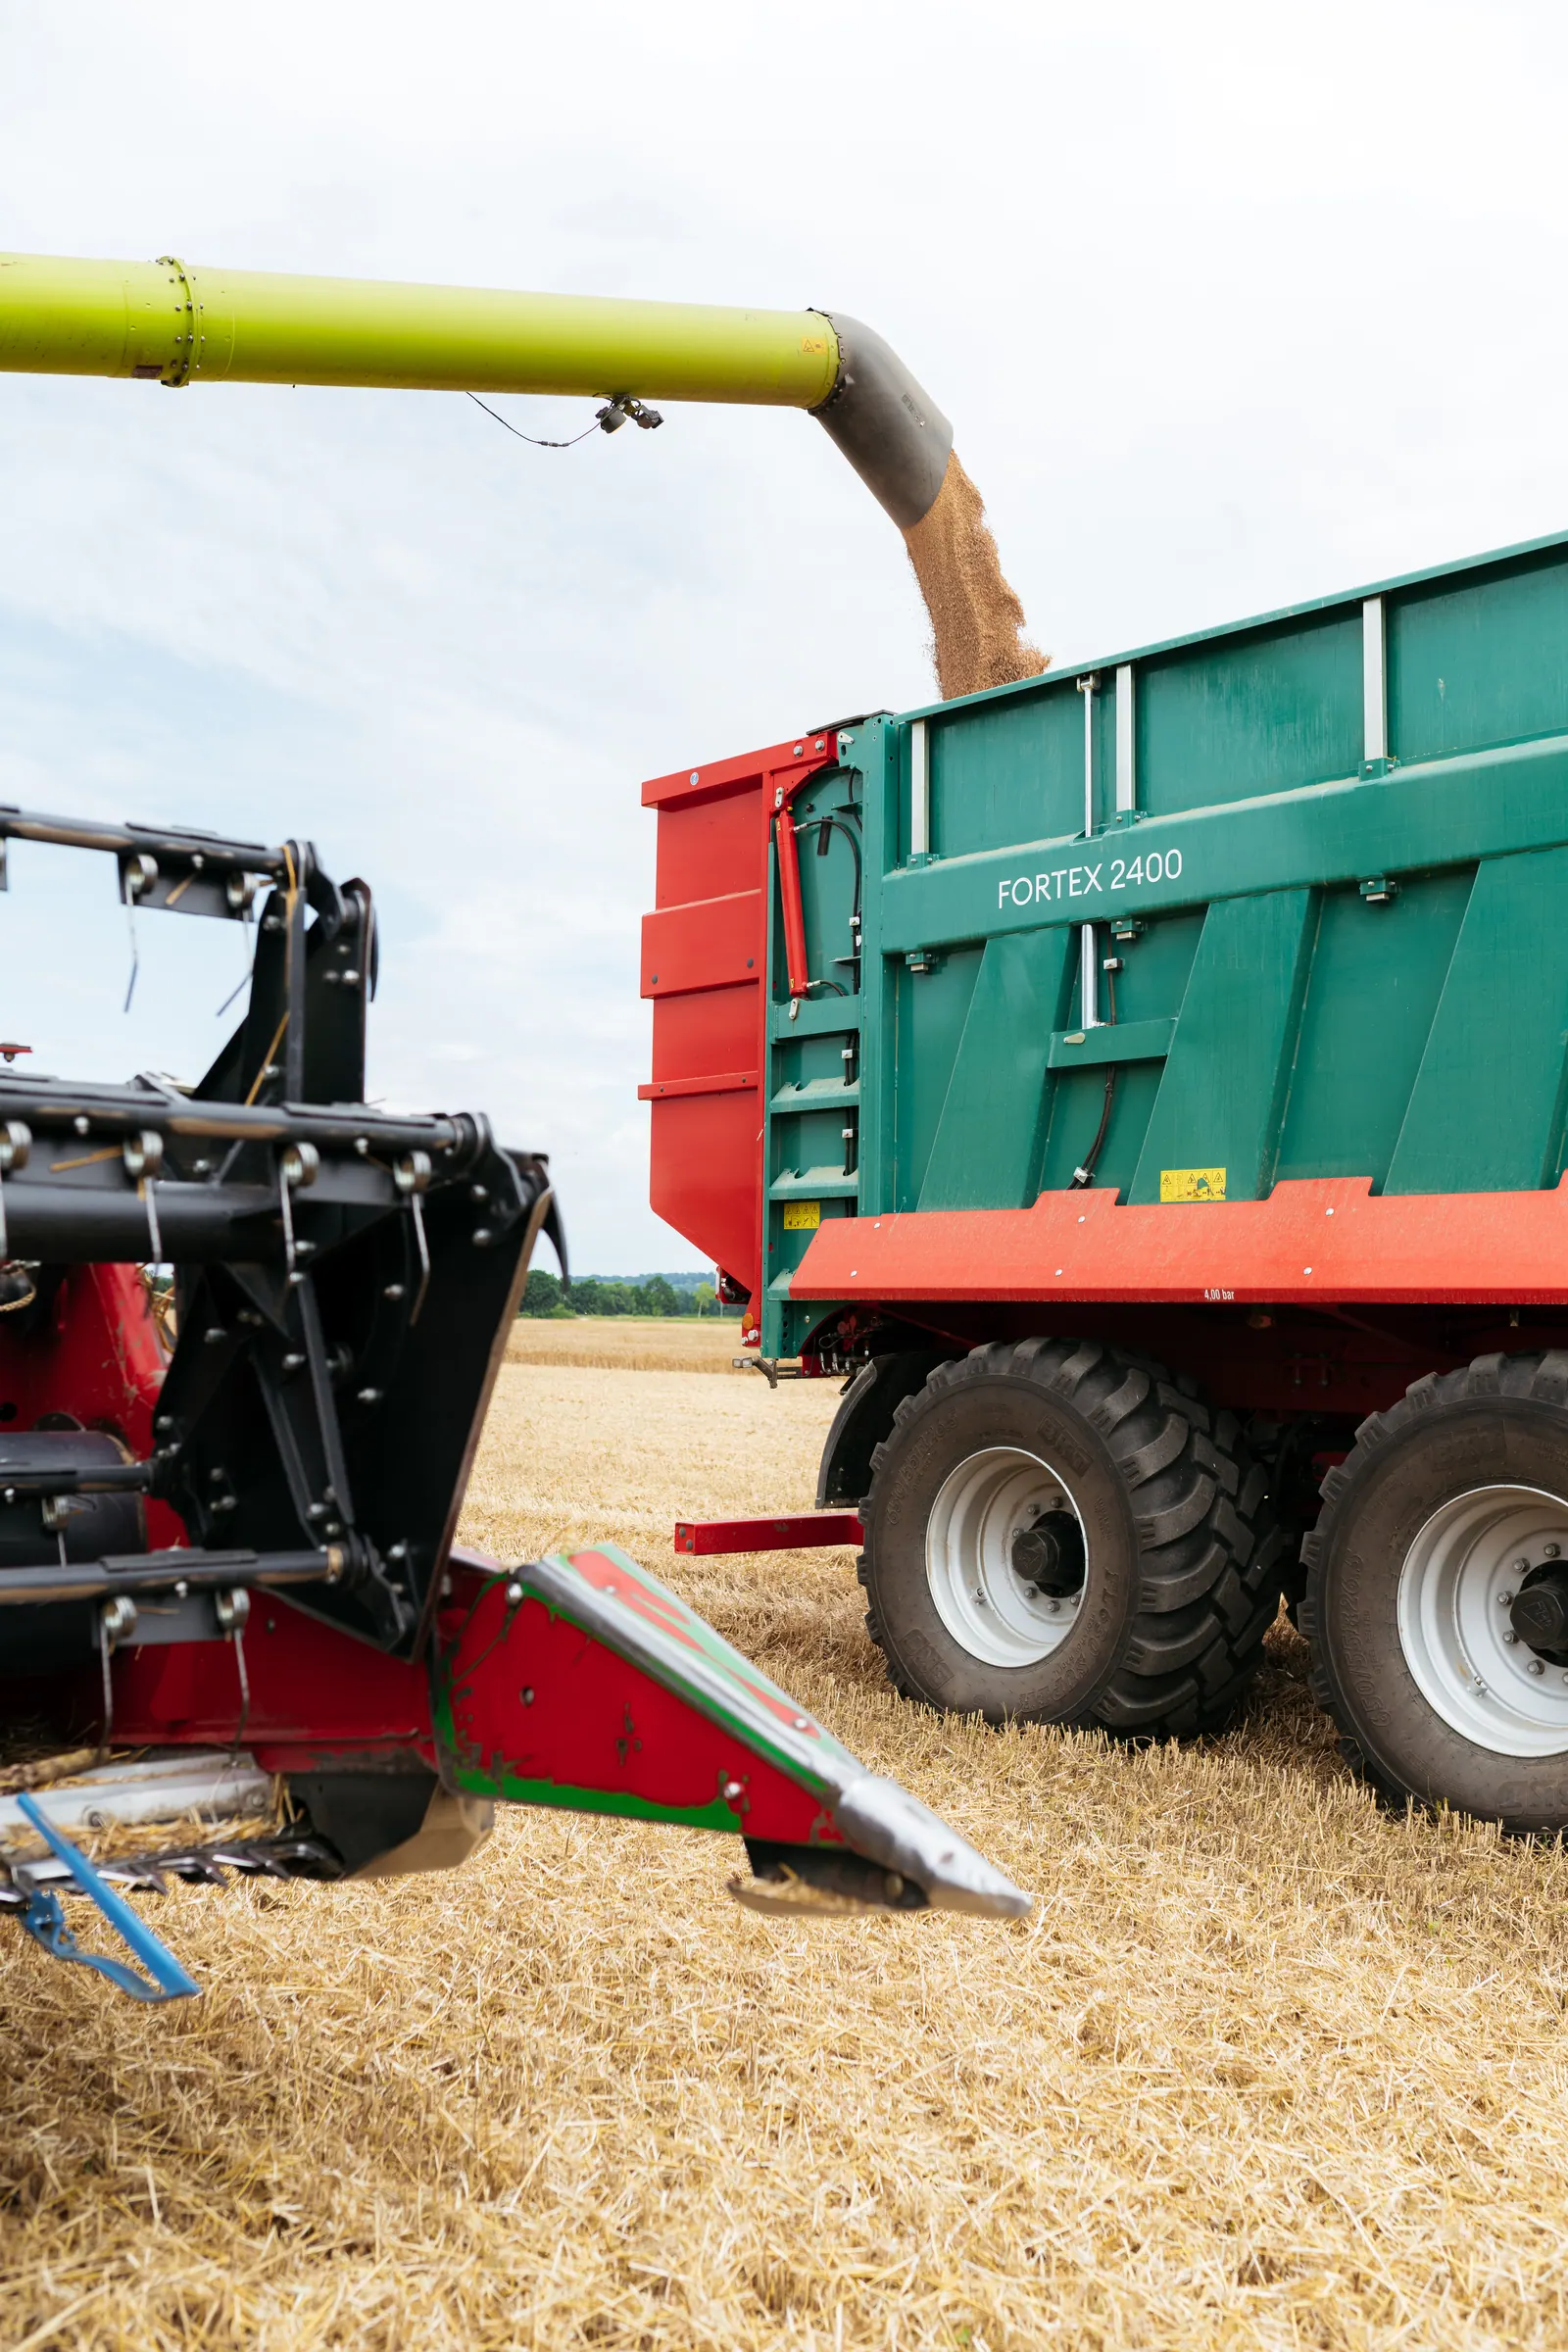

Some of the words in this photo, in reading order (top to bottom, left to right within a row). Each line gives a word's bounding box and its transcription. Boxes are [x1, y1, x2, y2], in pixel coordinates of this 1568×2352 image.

[998, 863, 1103, 909] FORTEX
[1110, 849, 1183, 890] 2400
[1203, 1289, 1220, 1301] 4,00
[1221, 1289, 1235, 1300] bar
[1038, 1414, 1093, 1477] BKT
[1340, 1547, 1393, 1727] 650/55R26.5
